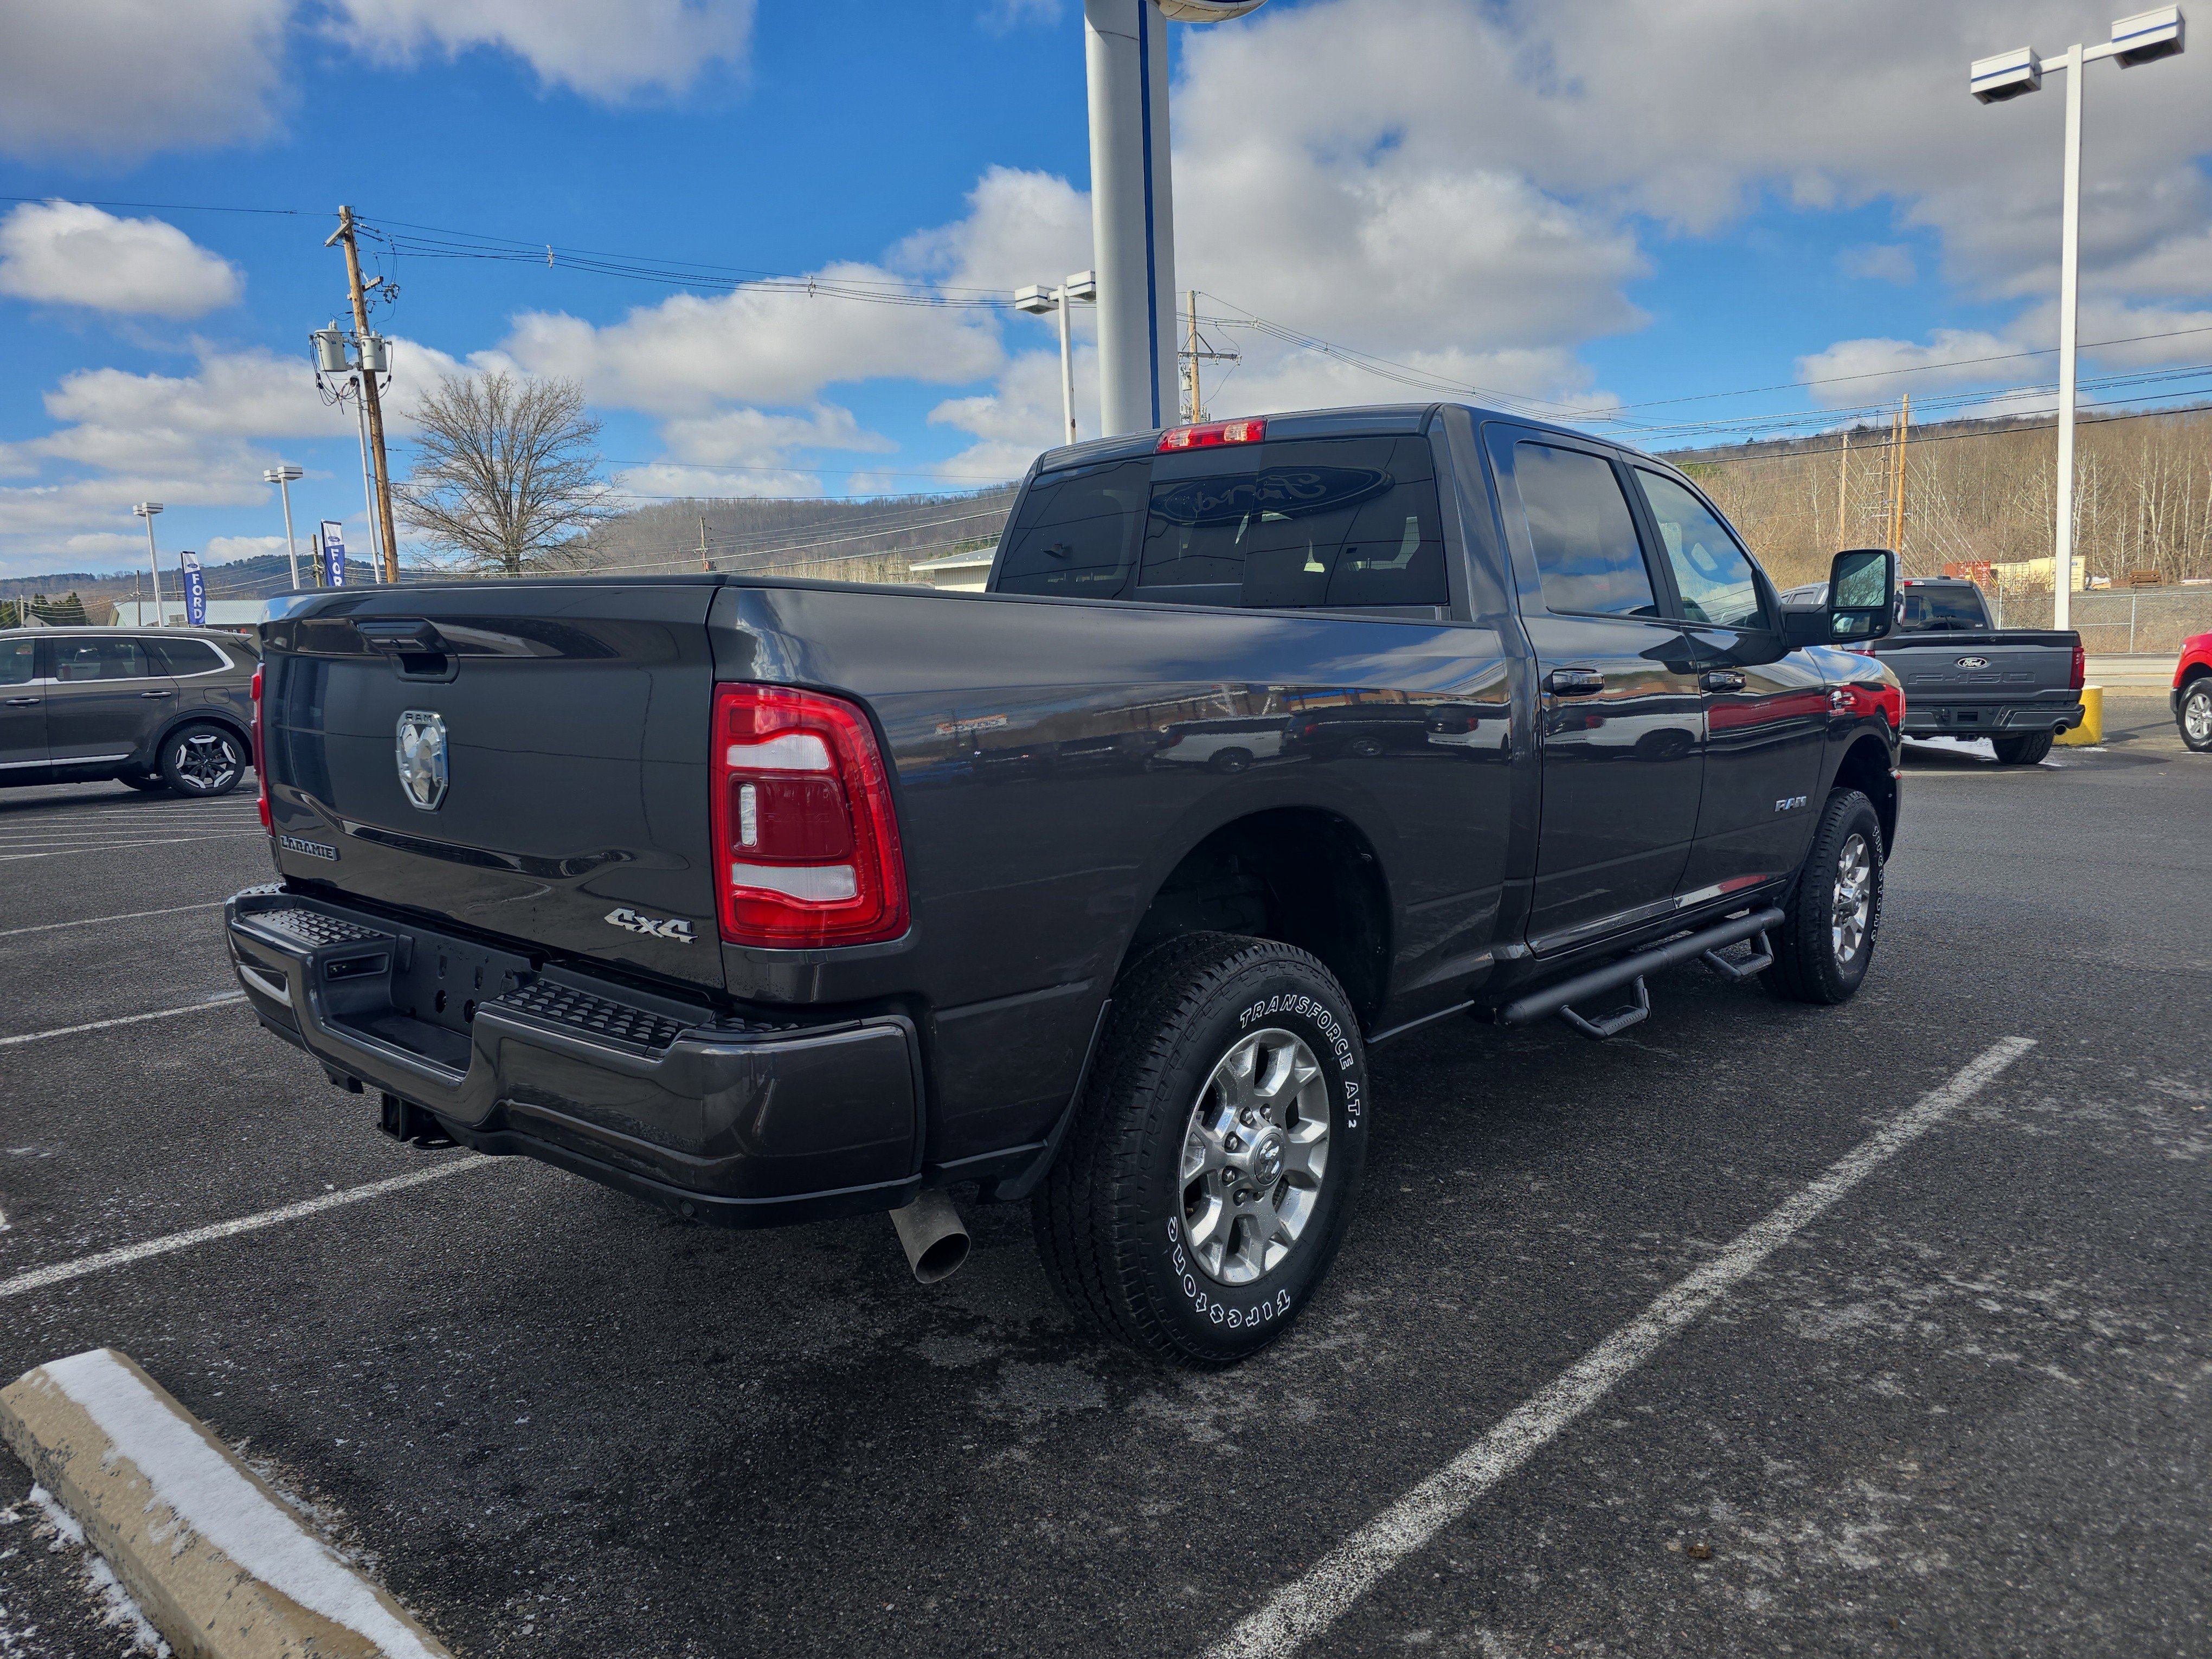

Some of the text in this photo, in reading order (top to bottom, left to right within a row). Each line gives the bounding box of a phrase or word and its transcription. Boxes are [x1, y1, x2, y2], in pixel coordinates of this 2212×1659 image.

[331, 548, 343, 586] FOR
[192, 574, 202, 619] FORD
[1962, 658, 1983, 667] Ford
[1907, 672, 2035, 684] F-150
[405, 713, 433, 722] RAM
[1774, 795, 1807, 812] RAM
[280, 835, 335, 860] LARAMIE
[1239, 994, 1354, 1071] TRANSFORCE
